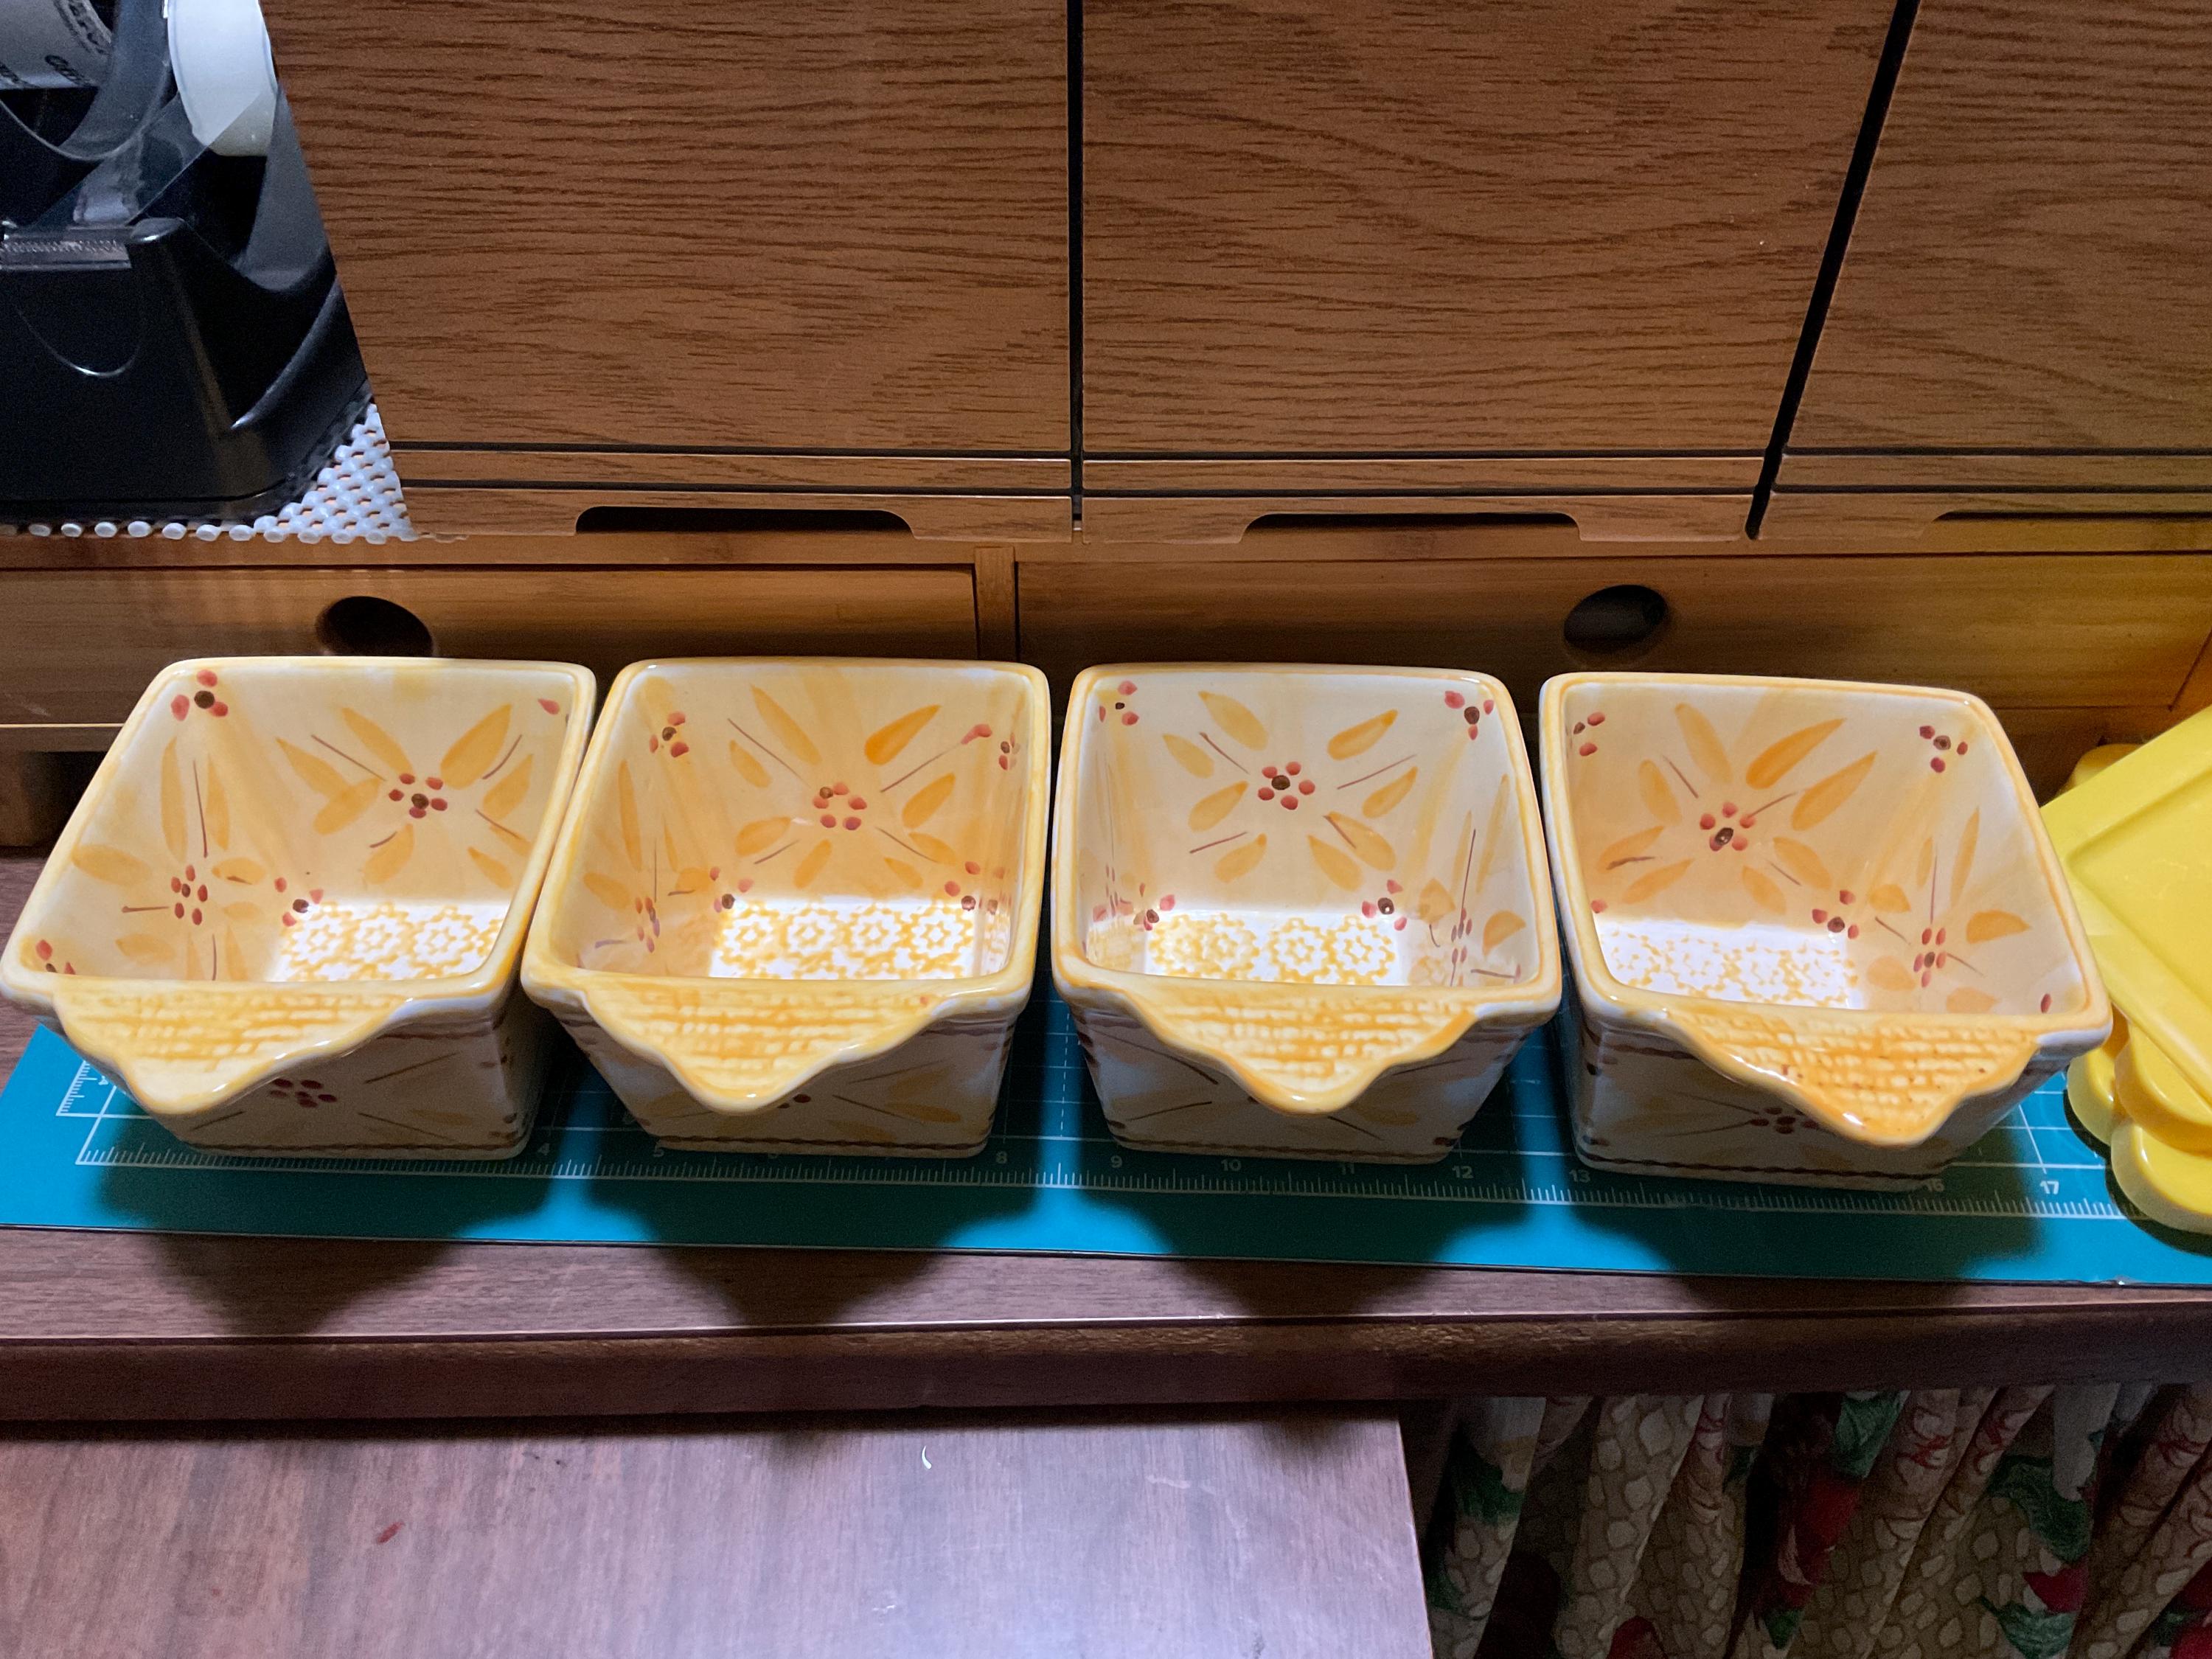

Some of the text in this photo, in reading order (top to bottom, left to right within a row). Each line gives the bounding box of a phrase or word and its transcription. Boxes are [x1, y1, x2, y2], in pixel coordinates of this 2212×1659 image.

[996, 1150, 1008, 1164] 8
[1110, 1155, 1123, 1168] 9
[1221, 1159, 1242, 1172] 10
[1338, 1162, 1355, 1175] 11
[1452, 1165, 1474, 1179] 12
[1569, 1169, 1591, 1183] 13
[2040, 1180, 2059, 1194] 17
